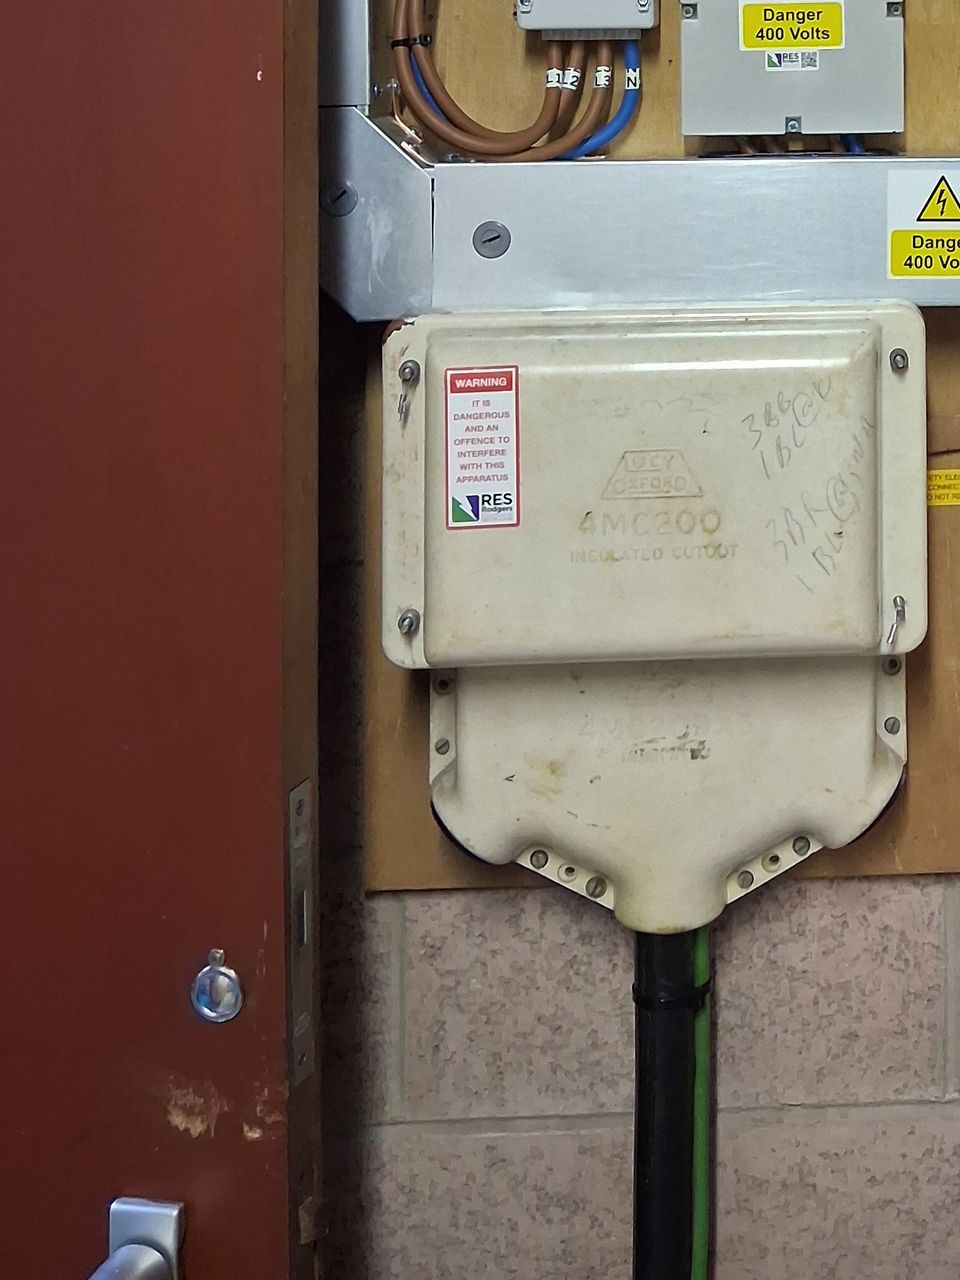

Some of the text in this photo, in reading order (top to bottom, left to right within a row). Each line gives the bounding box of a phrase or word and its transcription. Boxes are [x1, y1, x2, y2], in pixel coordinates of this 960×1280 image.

[763, 8, 823, 25] Danger
[755, 27, 830, 41] 400 Volts
[782, 52, 799, 60] RES
[627, 76, 637, 88] N
[904, 255, 933, 269] 400
[455, 377, 507, 389] WARNING
[482, 399, 491, 407] IS
[453, 411, 511, 421] DANGEROUS
[464, 423, 499, 433] AND AN
[453, 436, 511, 446] OFFENCE TO
[457, 448, 507, 458] INTERFERE
[459, 461, 505, 471] WITH THIS
[456, 473, 509, 484] APPARATUS
[611, 475, 689, 495] OXFORD
[481, 493, 513, 506] RES
[481, 505, 513, 514] Rodgers
[579, 509, 721, 536] 4MC200
[570, 542, 739, 562] INSULATED CUTOUT
